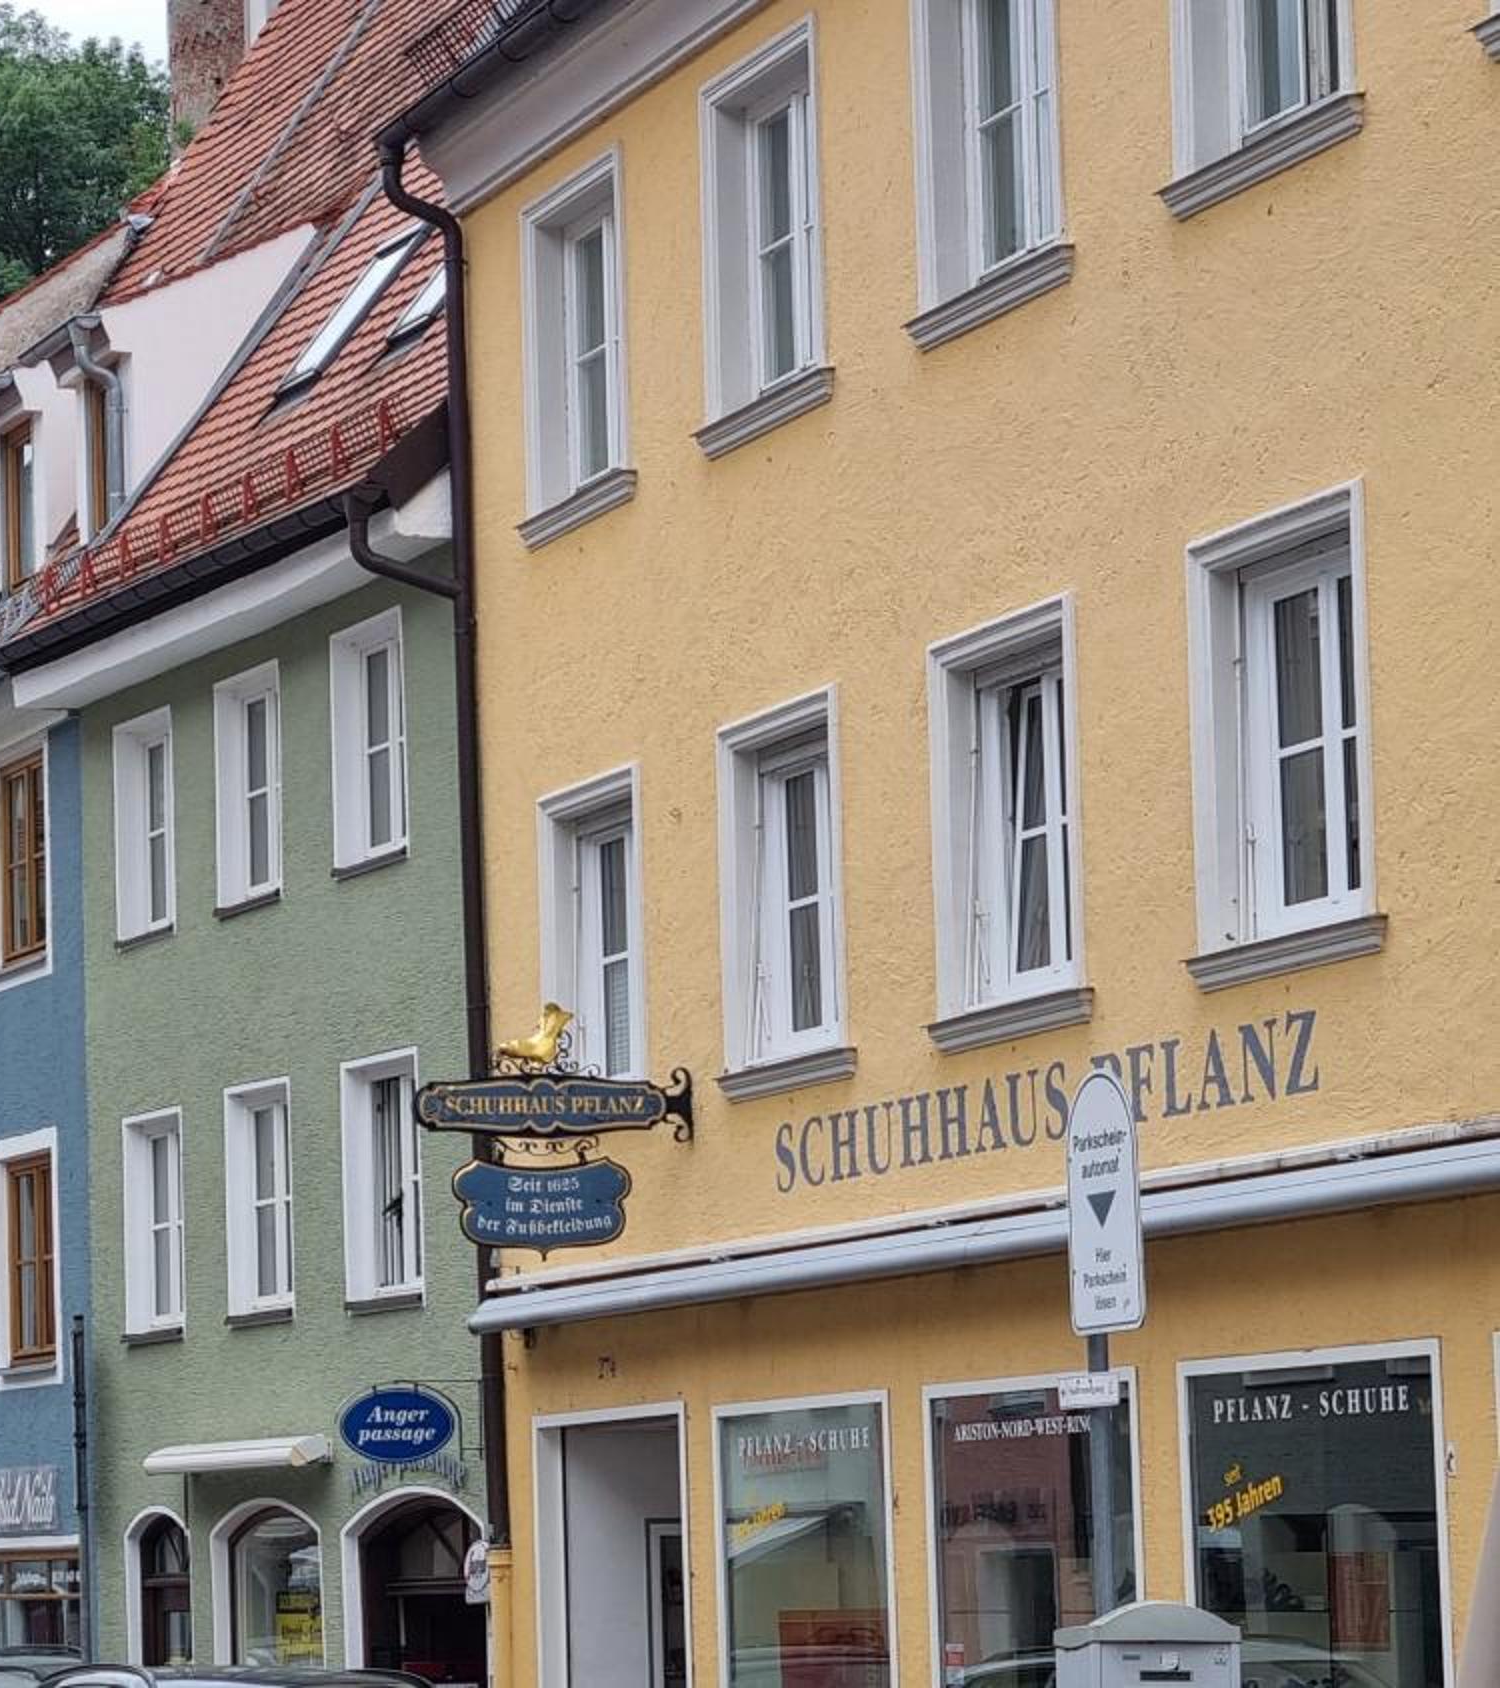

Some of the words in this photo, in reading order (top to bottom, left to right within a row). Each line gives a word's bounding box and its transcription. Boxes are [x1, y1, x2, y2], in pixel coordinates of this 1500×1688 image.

[445, 1095, 566, 1115] SCHUHHAUS
[571, 1095, 646, 1115] PFLANZ
[775, 1061, 1068, 1193] SCHUHHAUS
[507, 1175, 542, 1193] Seit
[505, 1197, 524, 1213] im
[477, 1215, 501, 1232] der
[1212, 1393, 1293, 1424] PFLANZ
[1319, 1384, 1410, 1417] SCHUHE
[366, 1405, 430, 1427] Anger
[357, 1427, 437, 1446] passage
[738, 1433, 792, 1457] PFLANZ
[808, 1426, 870, 1453] SCHUHE
[1206, 1498, 1234, 1534] 395
[1235, 1474, 1284, 1518] Jahren
